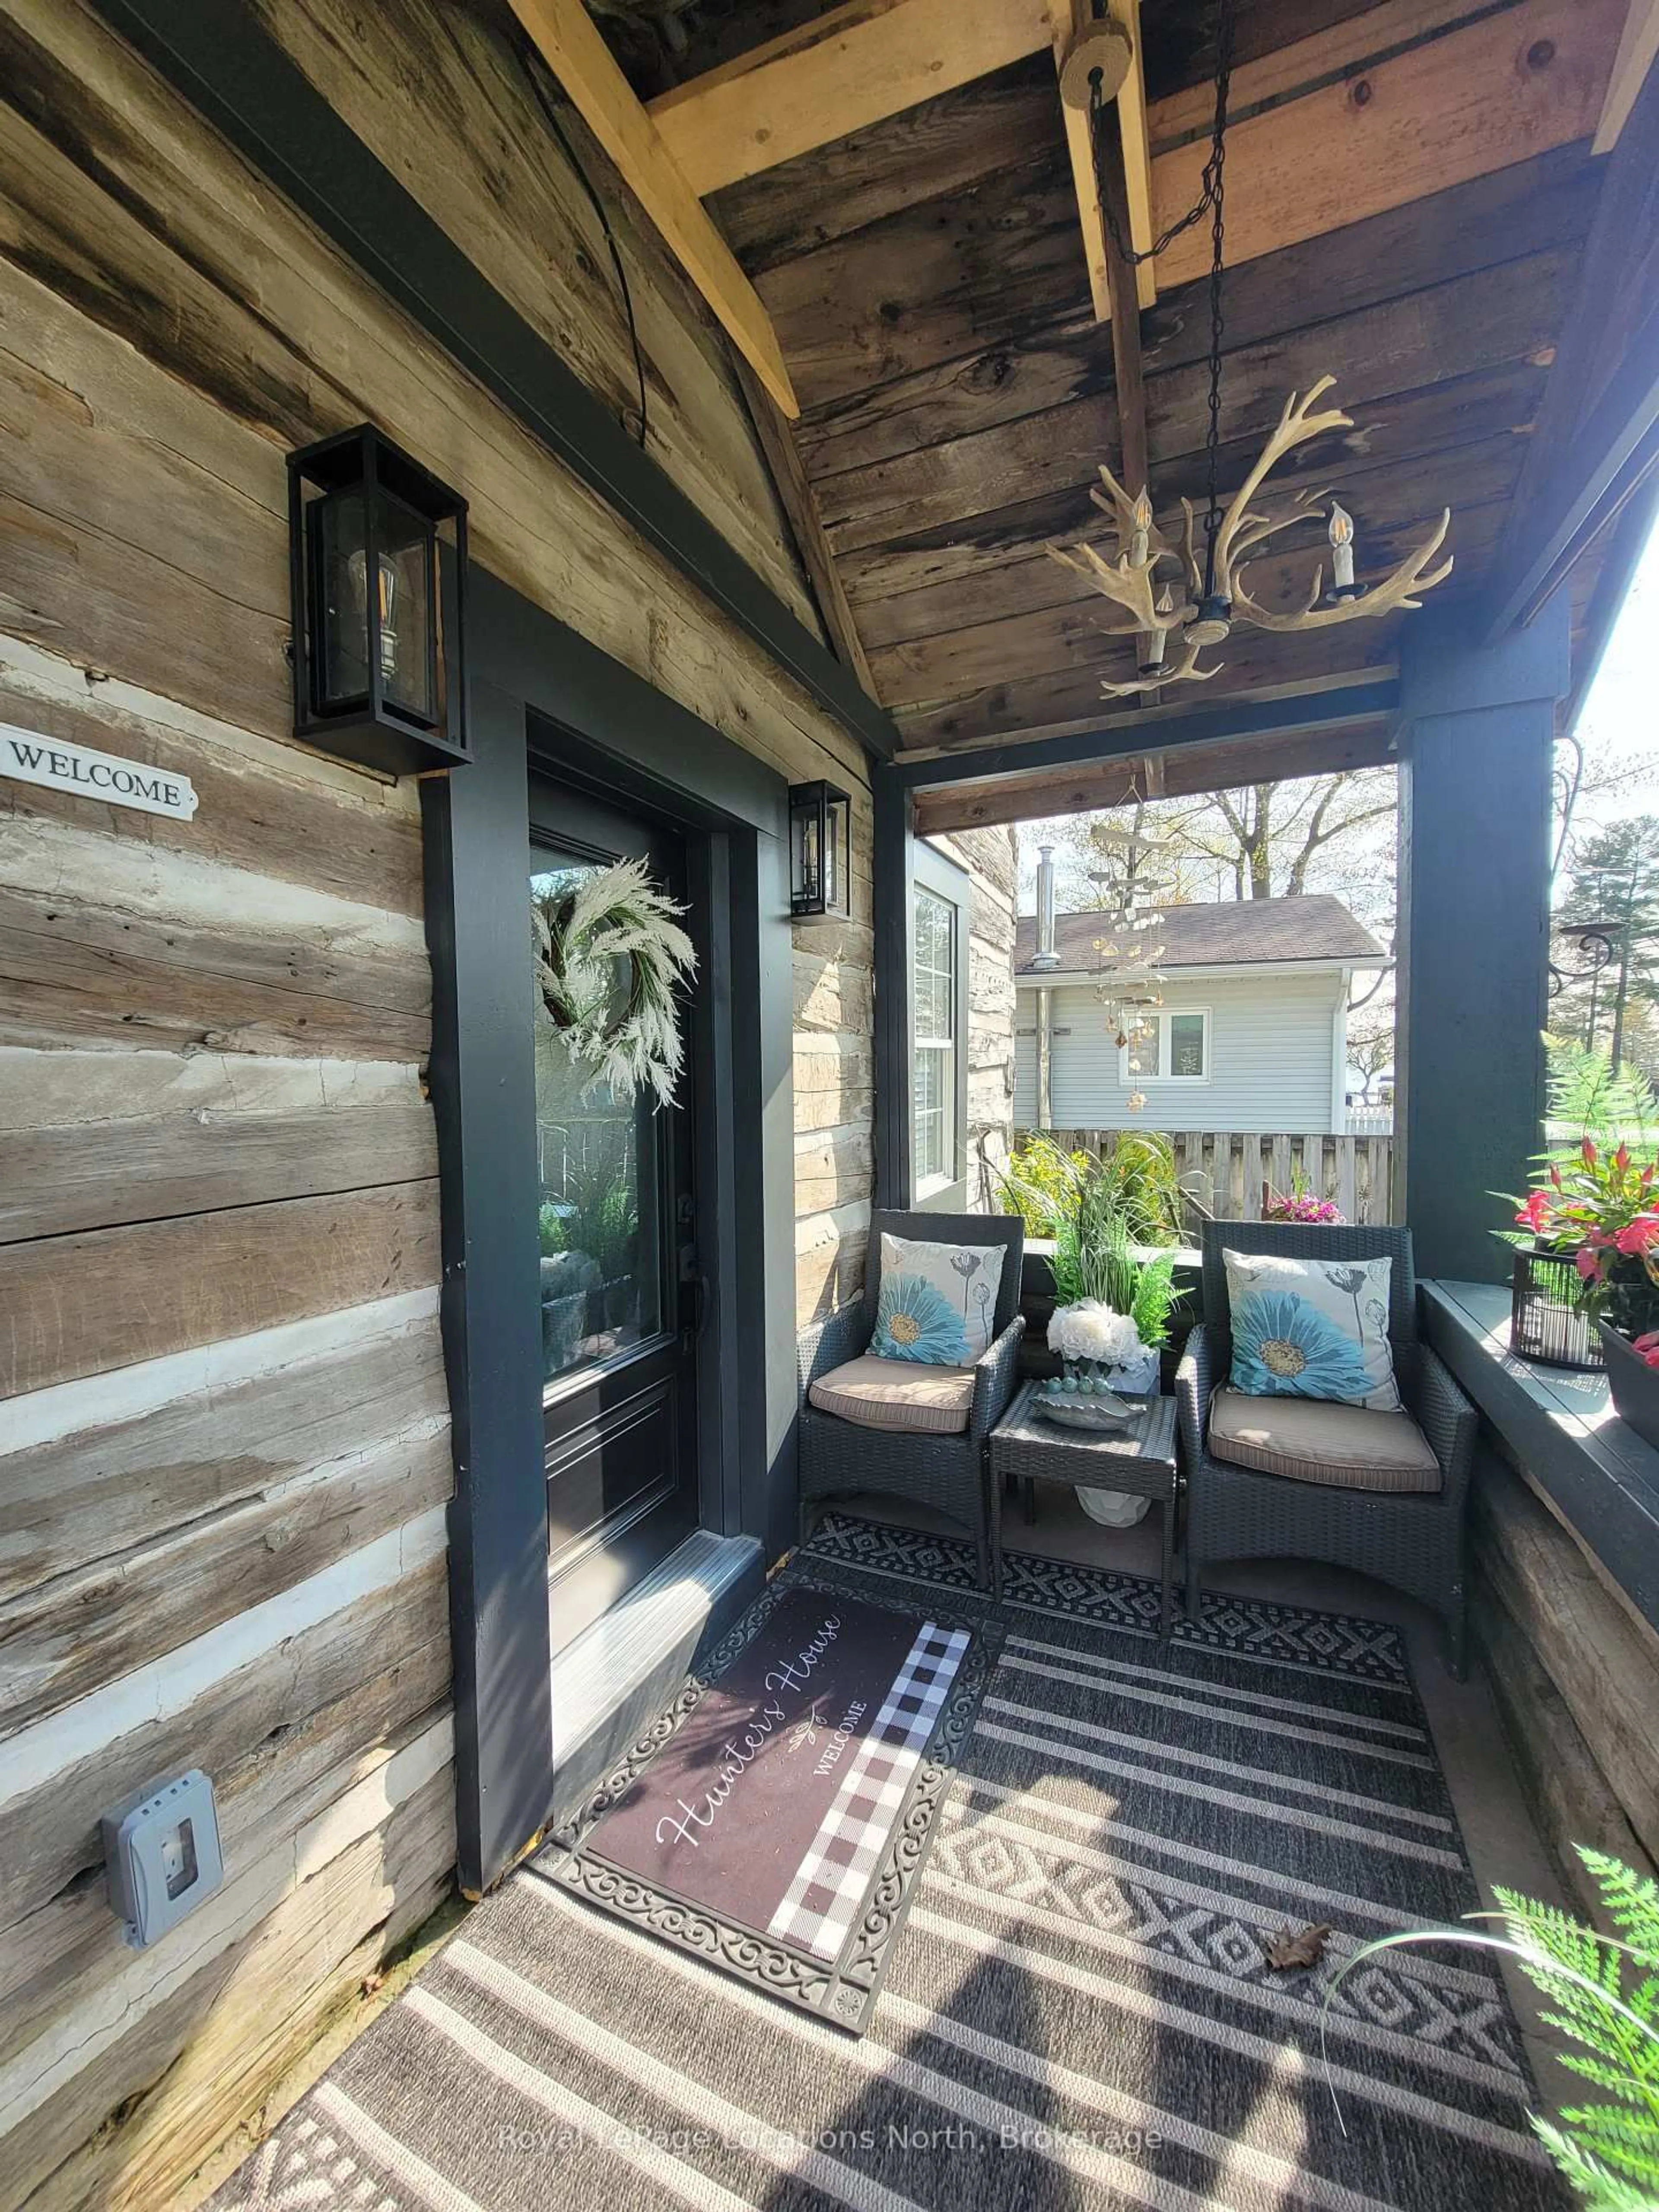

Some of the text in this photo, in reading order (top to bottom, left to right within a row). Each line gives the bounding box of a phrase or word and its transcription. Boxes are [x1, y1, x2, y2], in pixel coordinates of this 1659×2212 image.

[8, 740, 181, 807] WELCOME
[766, 1613, 841, 1692] House
[813, 1700, 868, 1778] WELCOME
